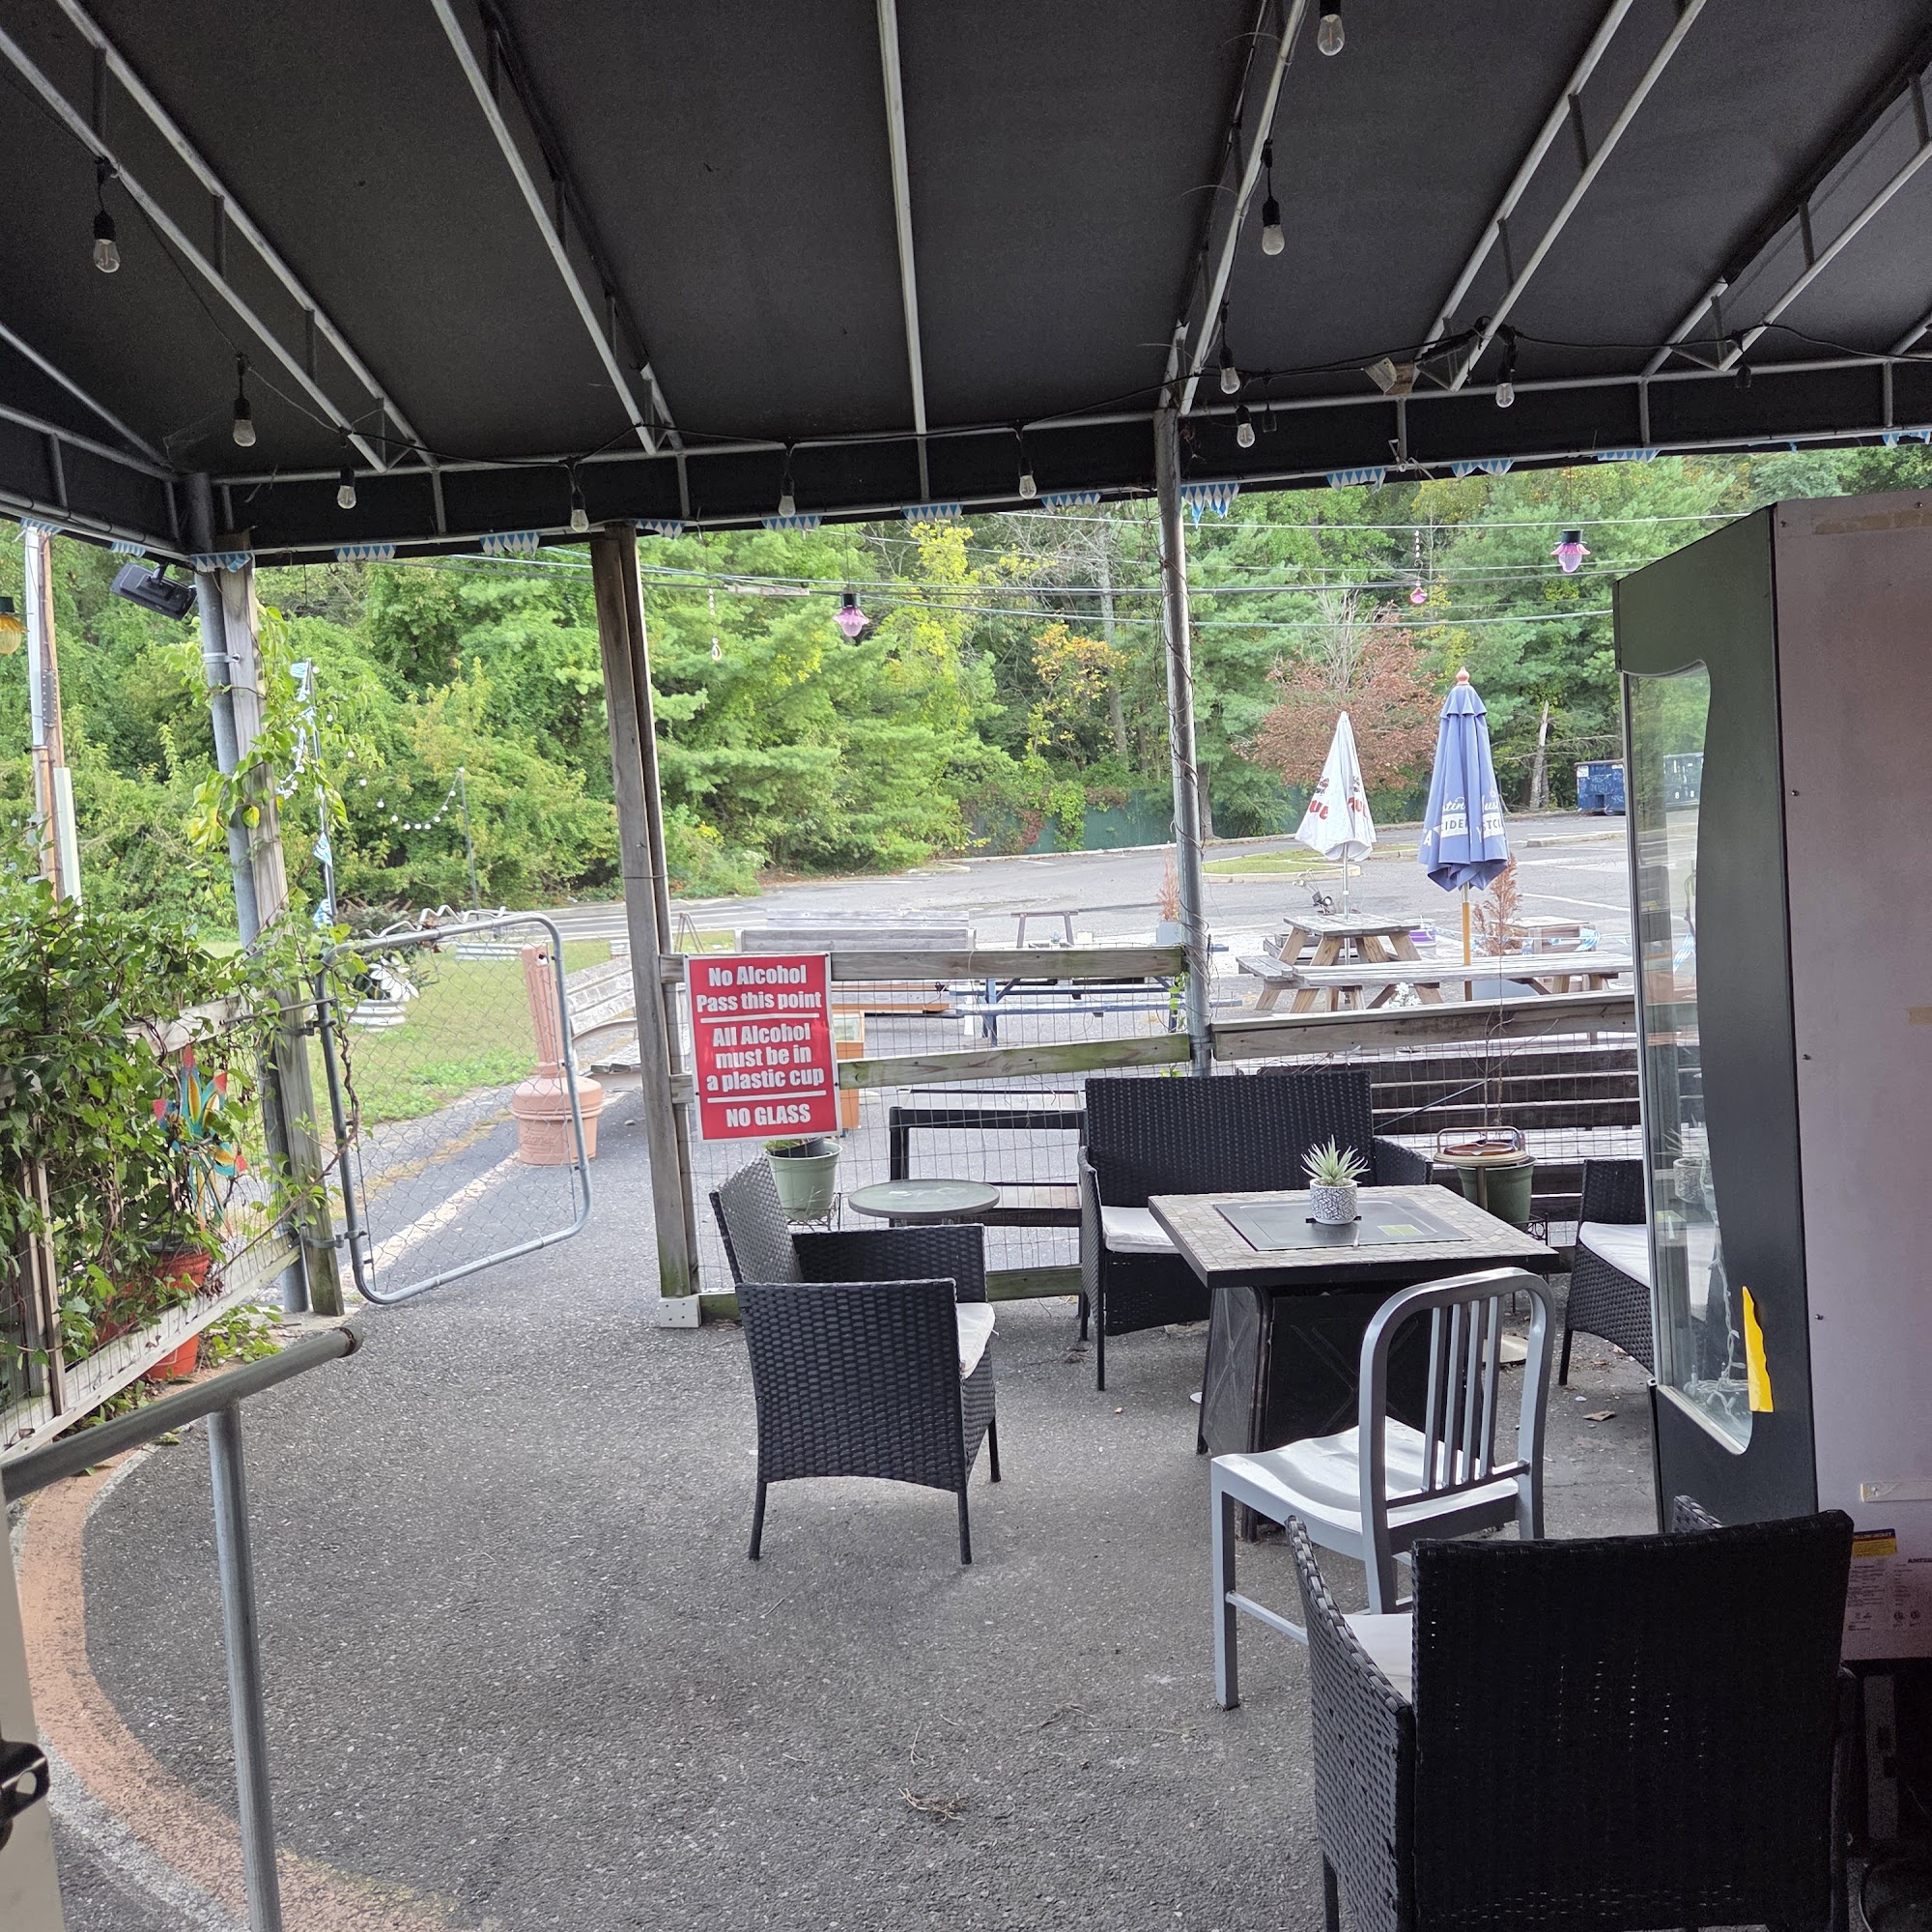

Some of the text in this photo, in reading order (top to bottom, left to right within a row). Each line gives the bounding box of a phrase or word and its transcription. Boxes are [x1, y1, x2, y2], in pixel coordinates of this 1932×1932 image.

[1440, 818, 1467, 832] IDE
[708, 964, 807, 987] No Alcohol
[696, 990, 823, 1013] Pass this point
[712, 1022, 810, 1047] All Alcohol
[715, 1044, 812, 1069] must be in
[706, 1067, 825, 1093] a plastic cup
[725, 1103, 811, 1127] NO GLASS
